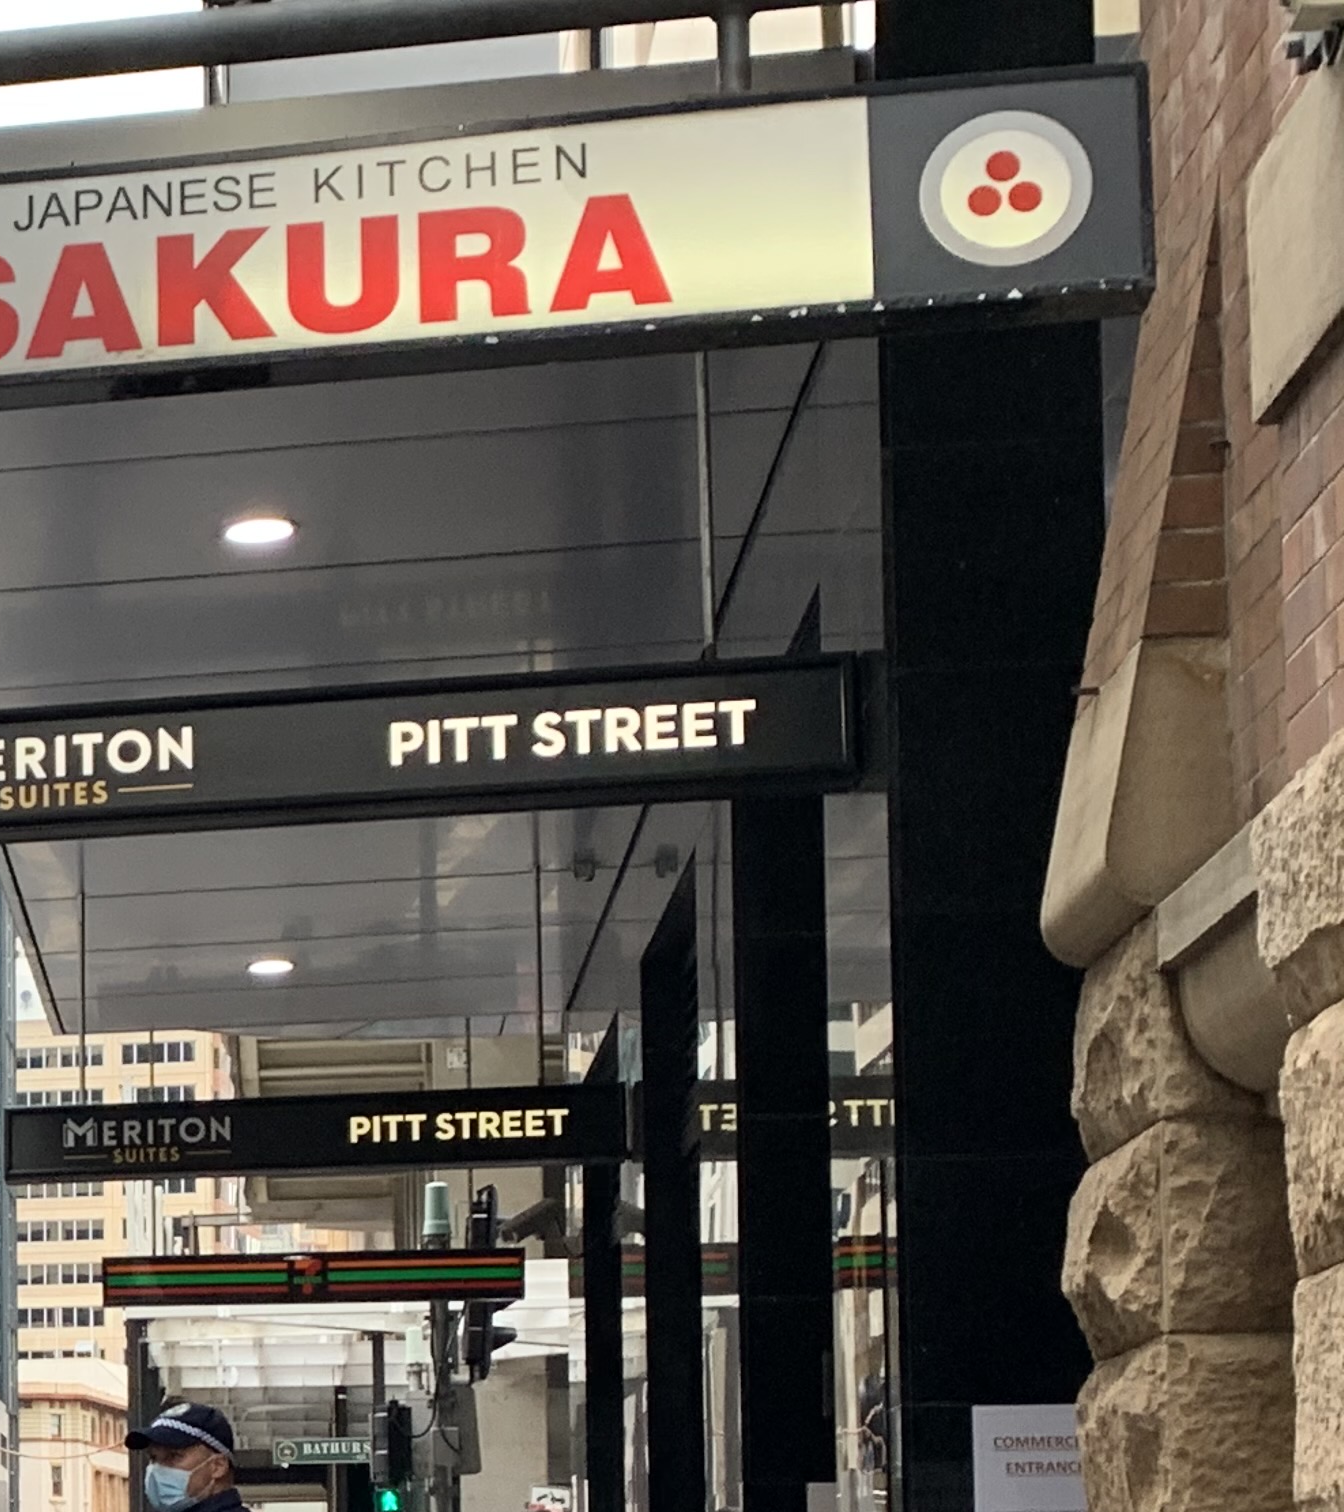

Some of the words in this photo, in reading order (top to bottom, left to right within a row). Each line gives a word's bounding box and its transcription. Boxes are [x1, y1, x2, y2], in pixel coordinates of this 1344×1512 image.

[13, 171, 278, 232] JAPANESE
[313, 142, 589, 203] KITCHEN
[388, 712, 518, 768] PITT
[531, 699, 756, 758] STREET
[63, 1116, 232, 1147] MERITON
[348, 1112, 425, 1145] PITT
[434, 1108, 569, 1141] STREET
[113, 1146, 180, 1164] SUITES
[303, 1441, 371, 1454] BATHURS
[993, 1436, 1079, 1449] COMMERCI
